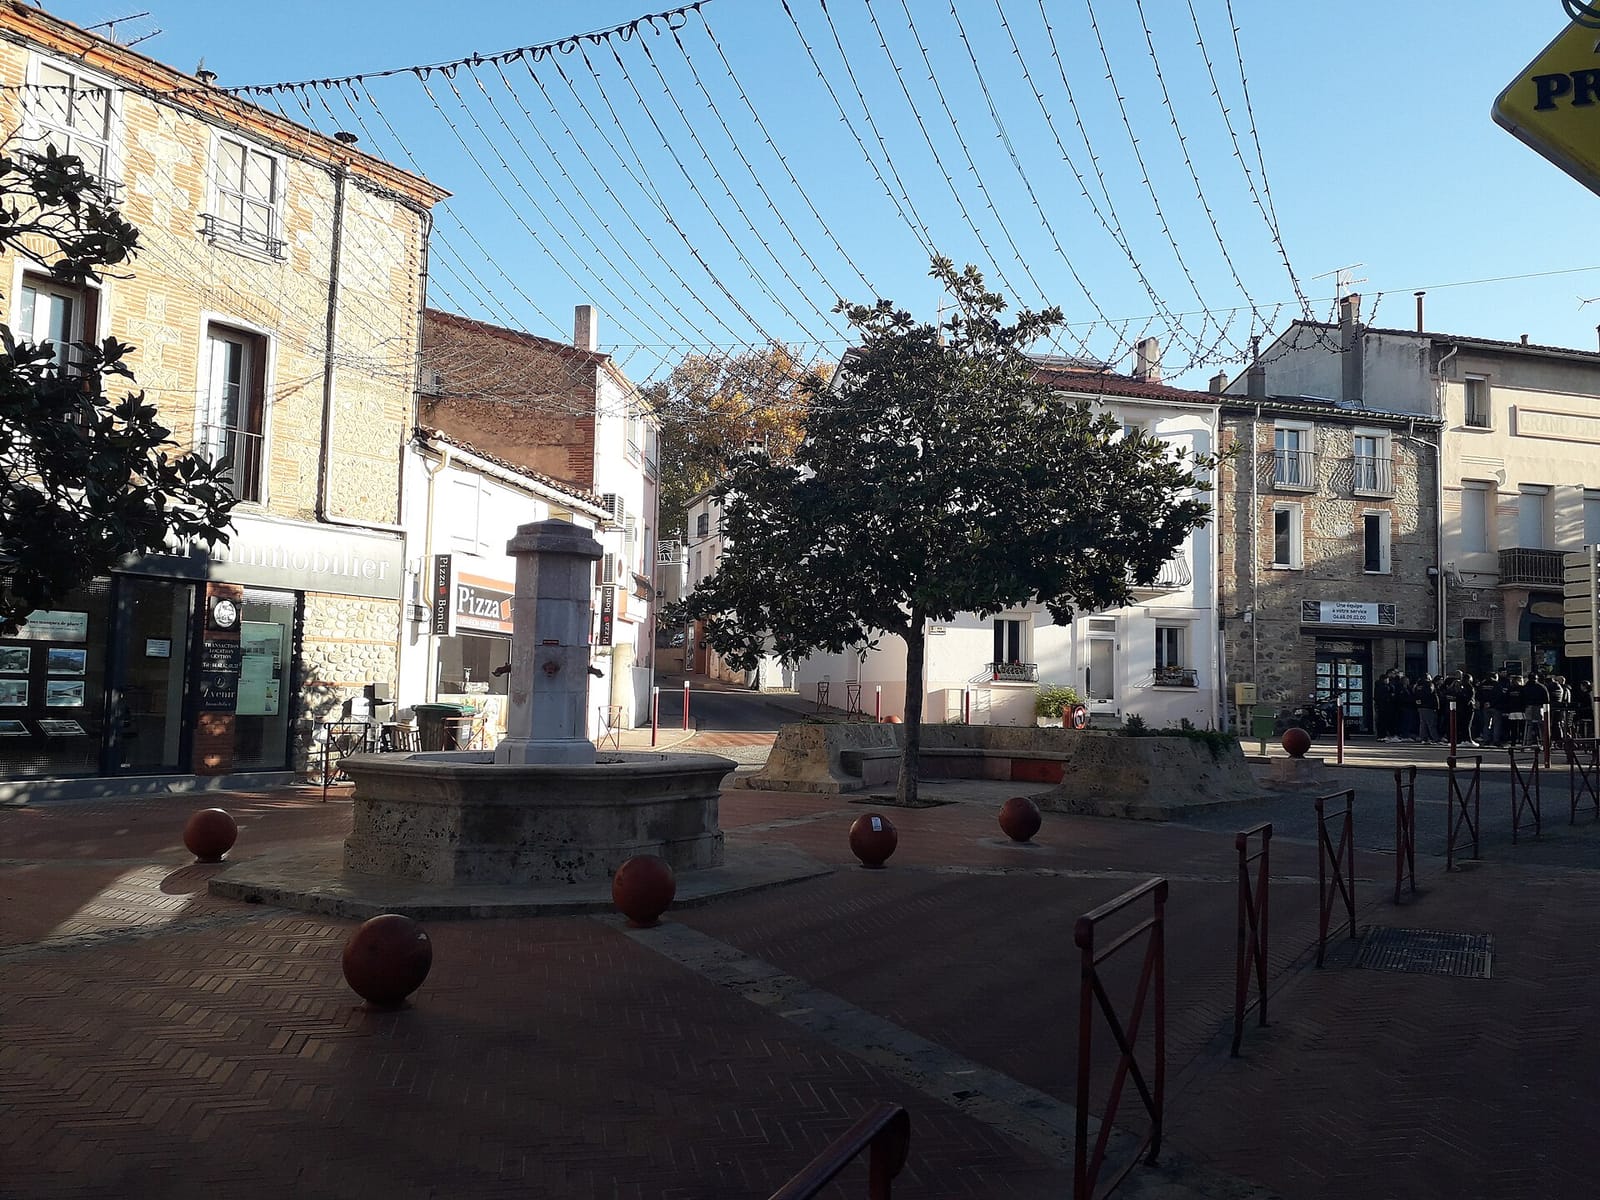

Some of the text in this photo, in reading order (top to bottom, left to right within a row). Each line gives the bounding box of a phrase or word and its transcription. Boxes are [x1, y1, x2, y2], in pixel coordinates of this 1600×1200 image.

[436, 556, 449, 634] Pizza Bonici
[457, 586, 501, 619] Pizza
[602, 587, 613, 645] Pizza Bonici
